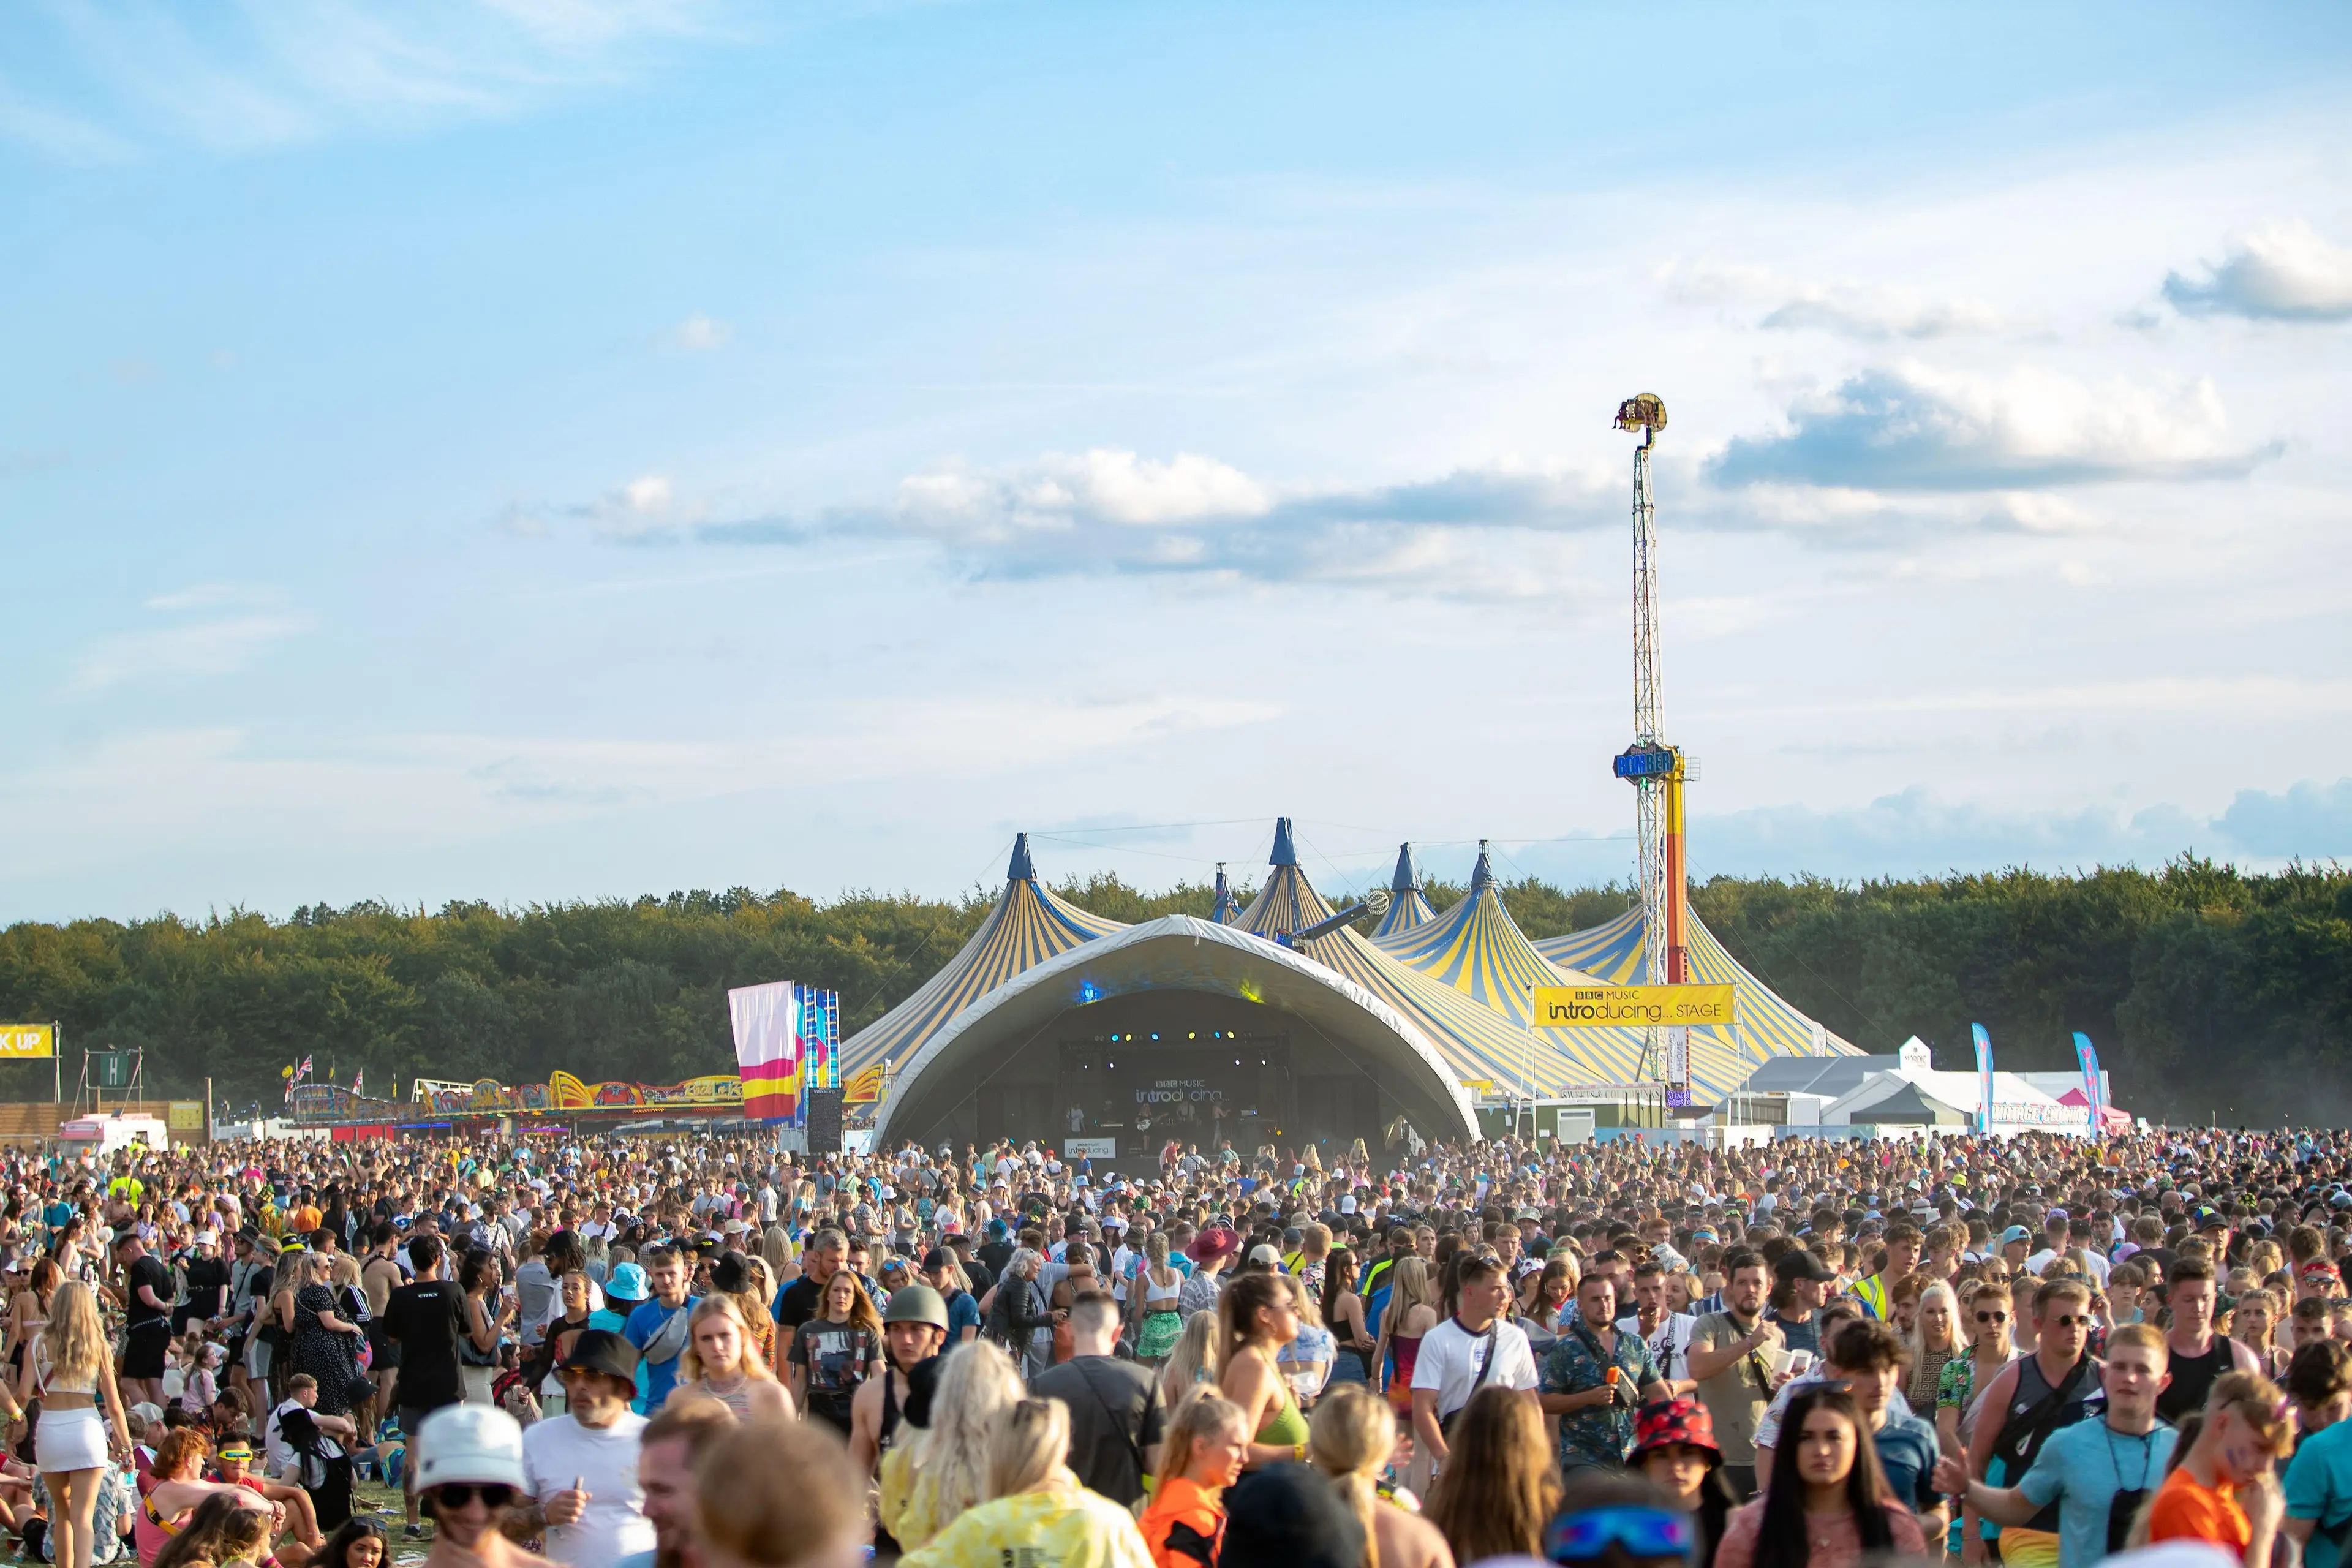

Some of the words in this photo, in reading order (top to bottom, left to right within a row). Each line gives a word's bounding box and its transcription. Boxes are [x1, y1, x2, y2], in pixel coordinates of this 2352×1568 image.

[1618, 752, 1671, 777] BOMBER
[1575, 991, 1603, 1000] BBC
[1606, 990, 1640, 1000] MUSIC
[1676, 1004, 1721, 1017] STAGE
[17, 1032, 40, 1050] UP
[108, 1057, 118, 1085] H
